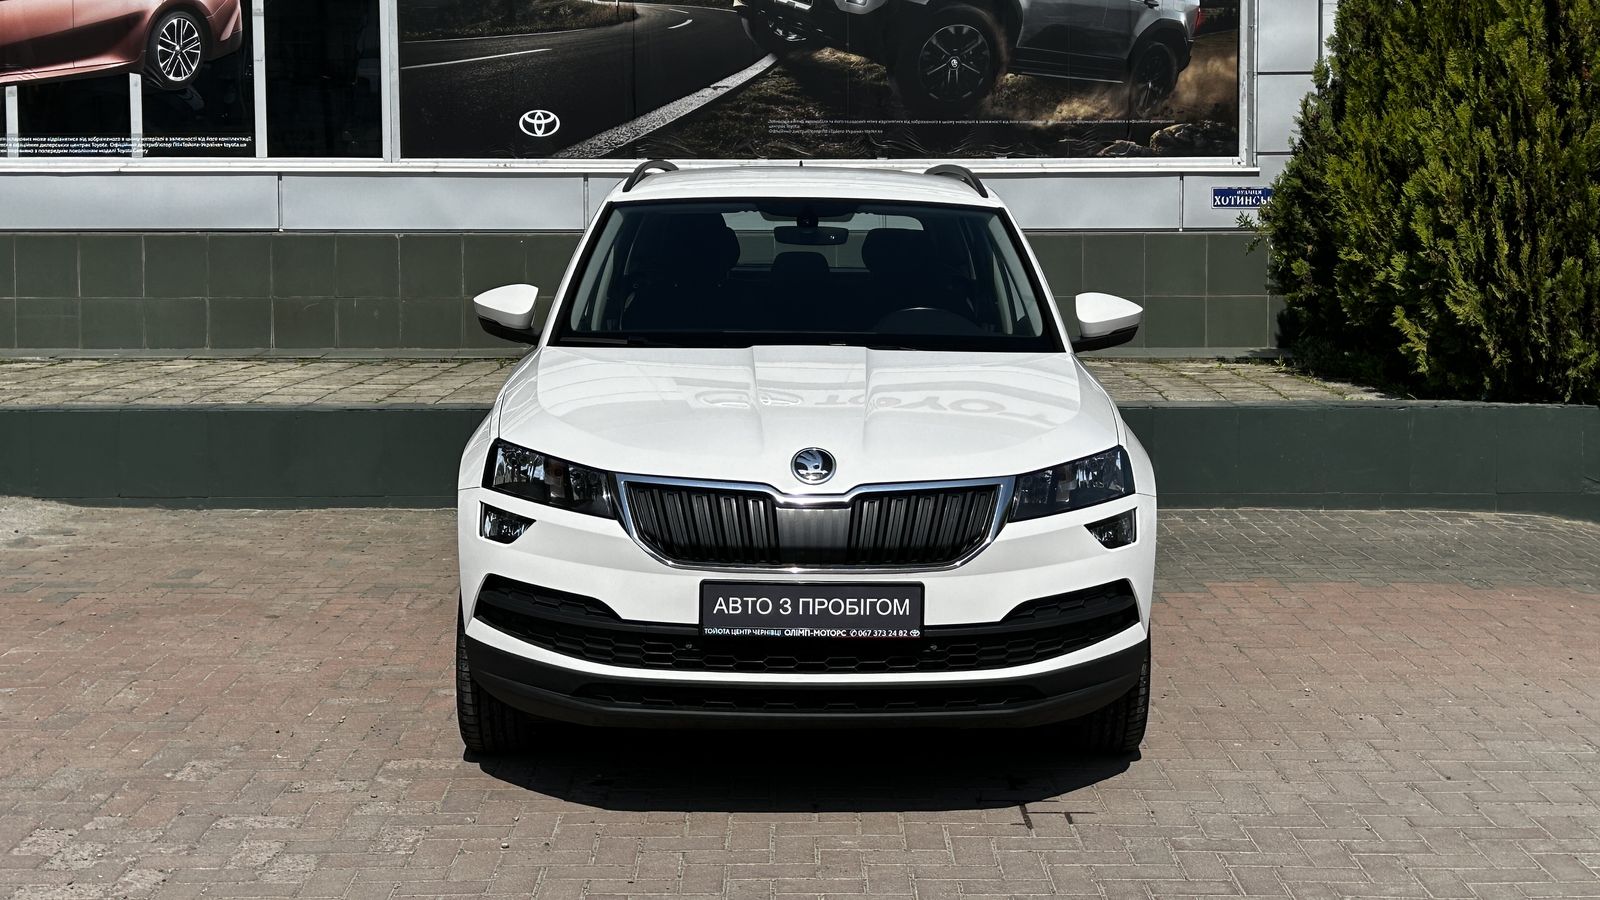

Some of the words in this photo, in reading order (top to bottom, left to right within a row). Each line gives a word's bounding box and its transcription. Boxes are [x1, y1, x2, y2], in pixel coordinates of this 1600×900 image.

[1214, 195, 1274, 205] ХОТИНСЬК
[713, 597, 773, 615] АВТО
[779, 598, 792, 615] З
[799, 597, 910, 616] ПРОБІГОМ
[704, 627, 730, 635] ТОЙОТА
[731, 628, 752, 636] ЦЕНТР
[752, 629, 782, 637] ЧЕРНІВЦІ
[784, 628, 847, 637] ОЛІМП-МОТОРС
[858, 629, 871, 637] 067
[873, 629, 887, 637] 373
[888, 629, 897, 637] 24
[898, 629, 908, 637] 82
